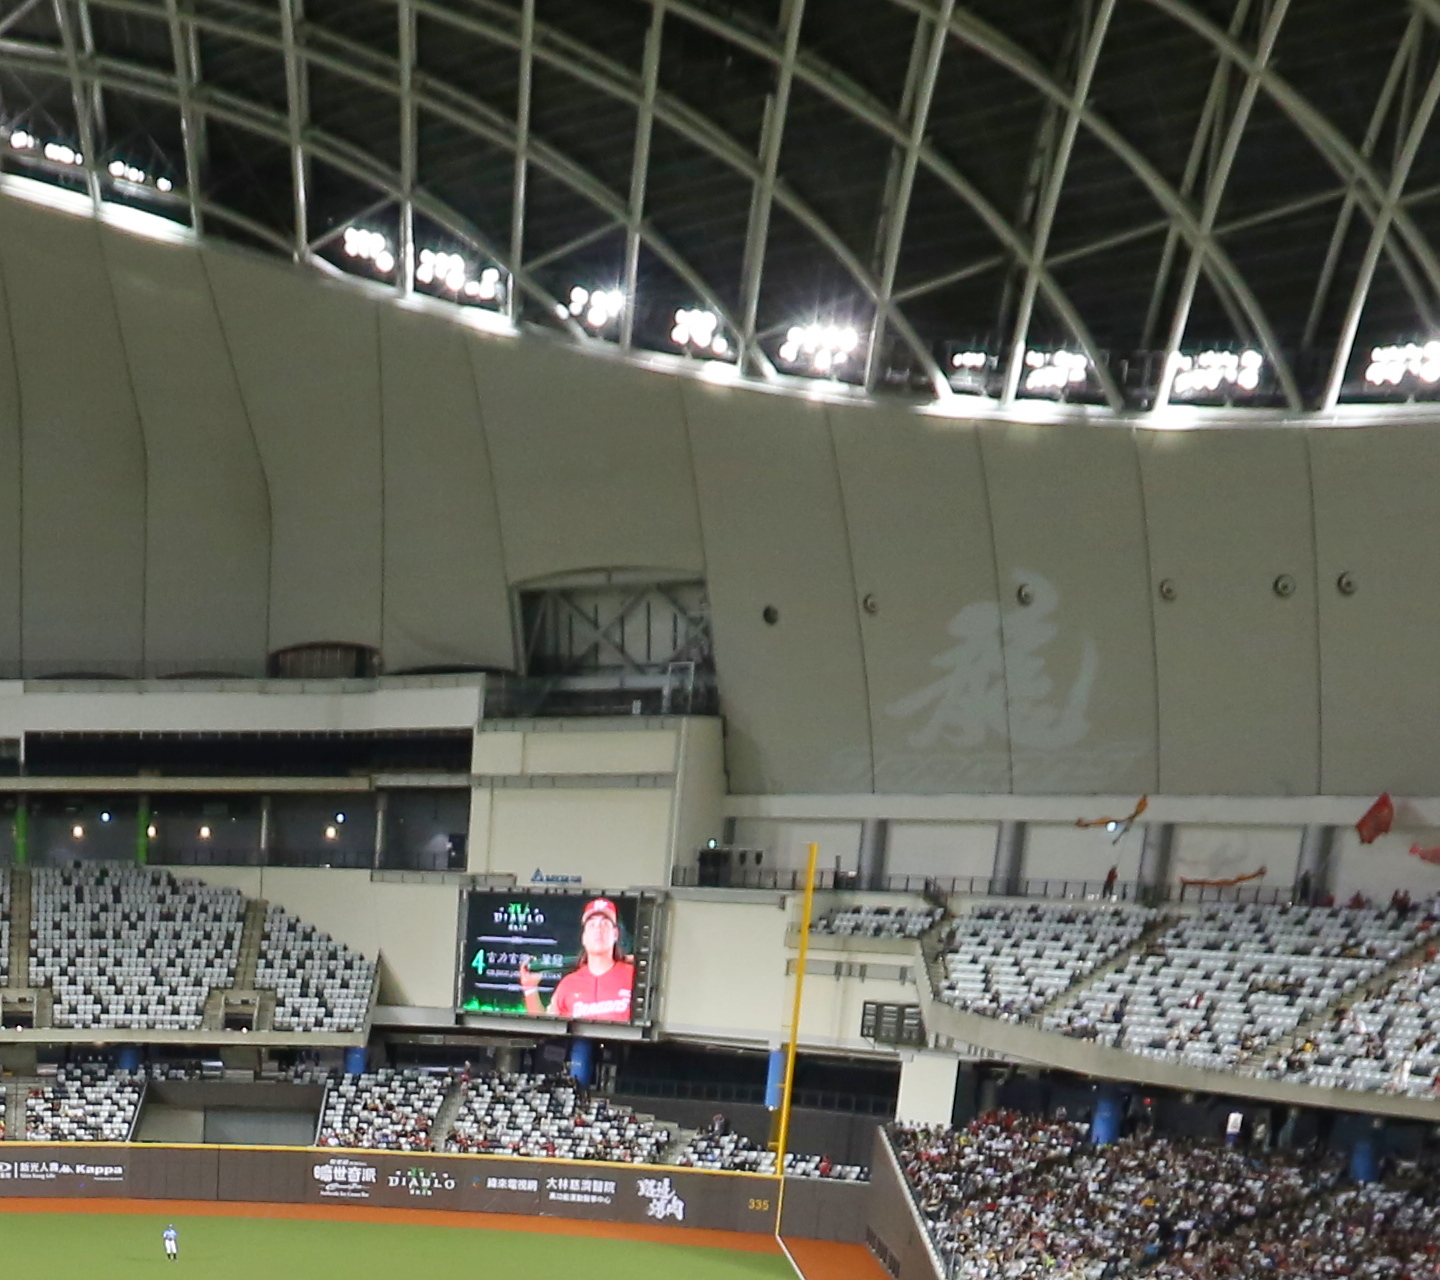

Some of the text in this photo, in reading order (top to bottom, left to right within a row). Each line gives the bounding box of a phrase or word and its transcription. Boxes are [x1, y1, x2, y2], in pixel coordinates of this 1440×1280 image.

[492, 912, 545, 924] DIABLO
[472, 949, 486, 975] 4
[76, 1164, 124, 1177] Kappa
[388, 1175, 456, 1190] DIABLO
[748, 1198, 770, 1212] 335
